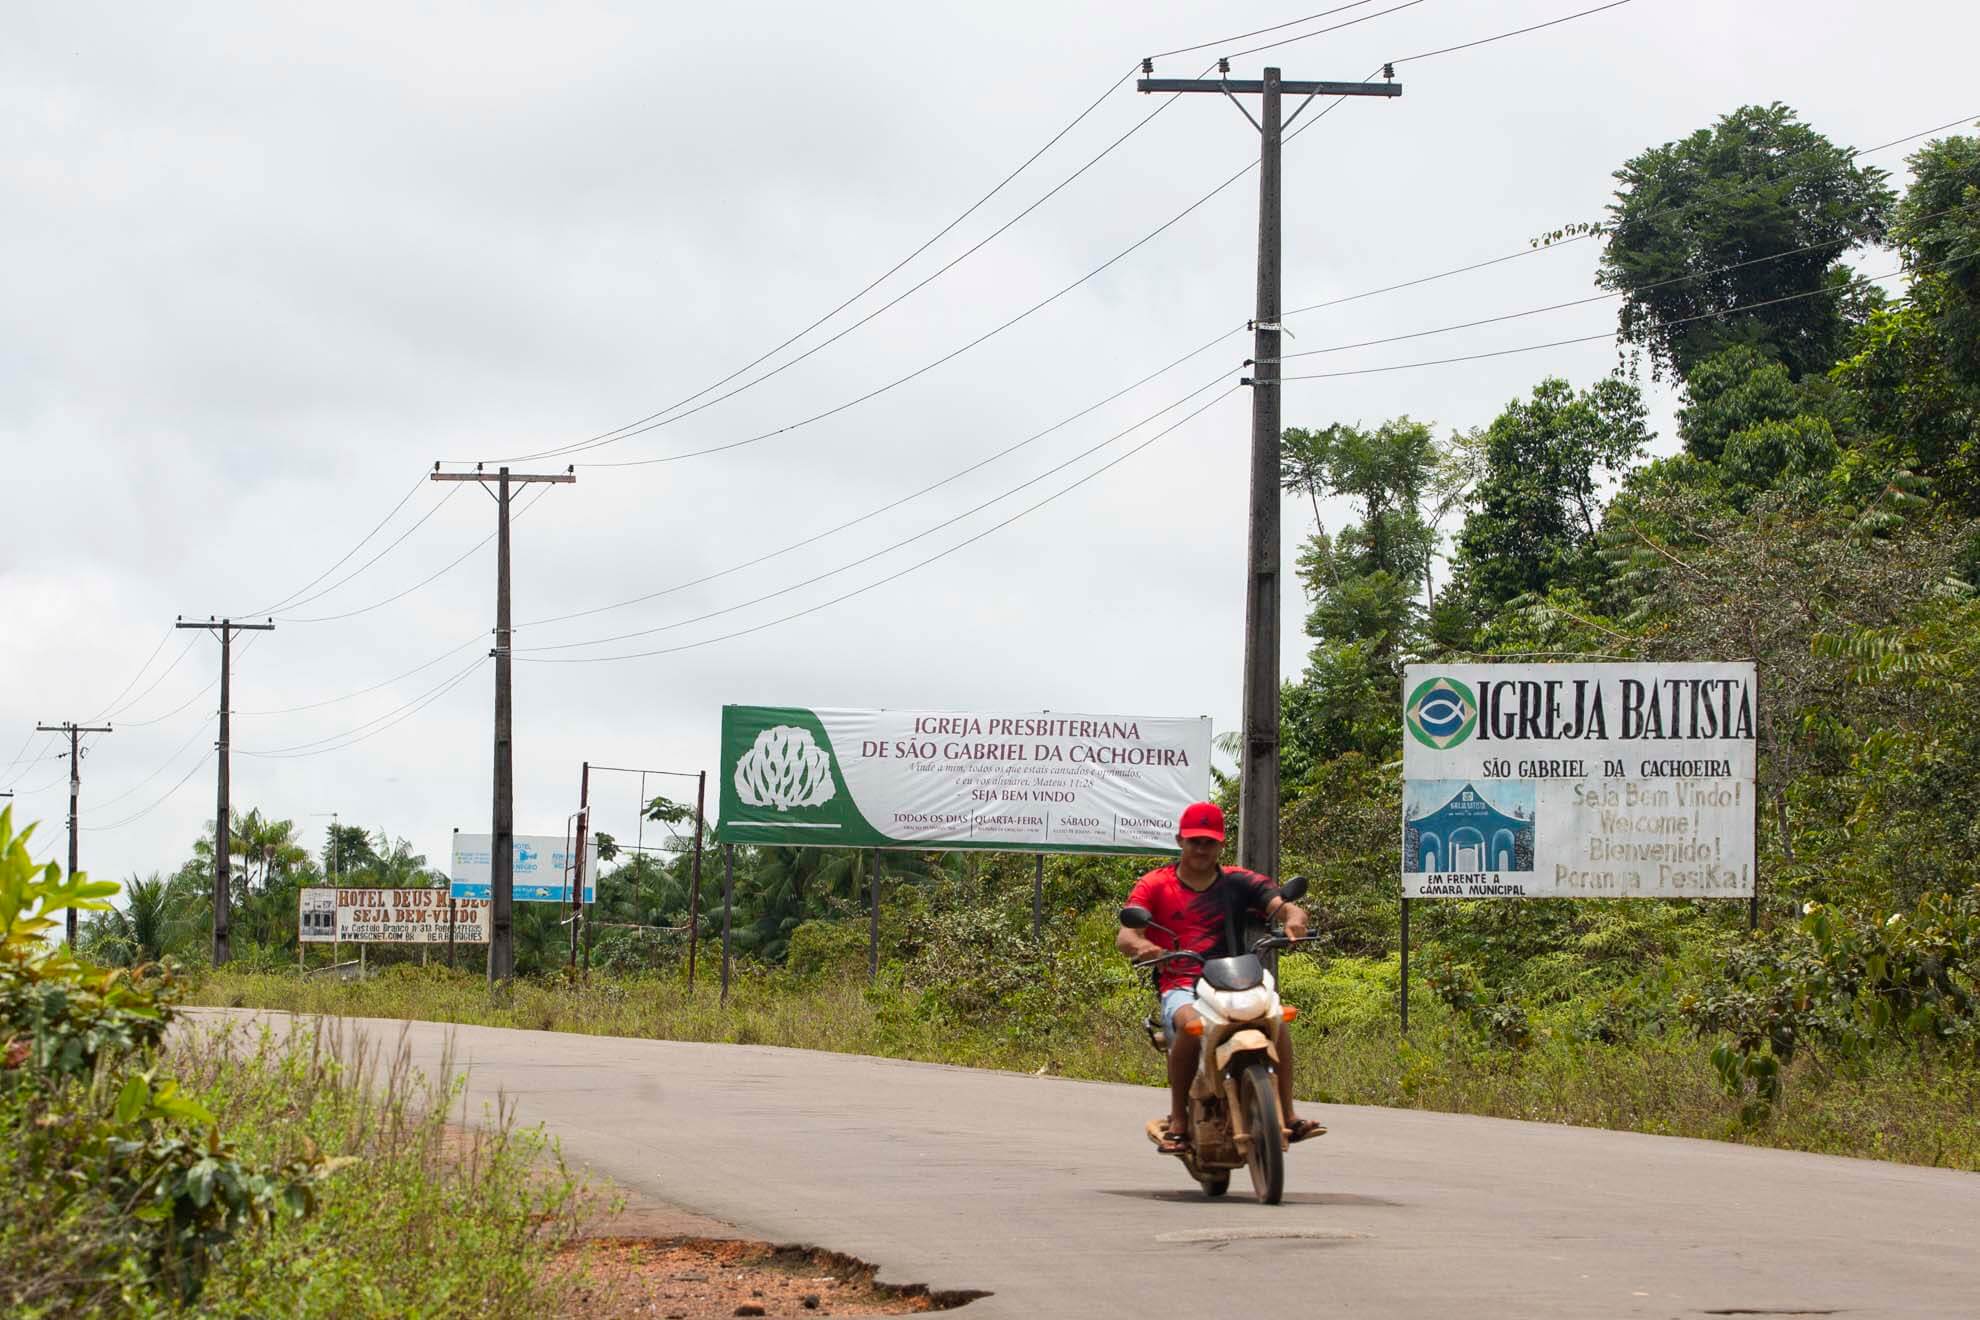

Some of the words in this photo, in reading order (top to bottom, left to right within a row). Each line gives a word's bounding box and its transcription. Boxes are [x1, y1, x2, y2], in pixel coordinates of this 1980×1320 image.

[1477, 679, 1608, 741] IGREJA
[1619, 678, 1755, 740] BATISTA
[915, 716, 981, 738] IGREJA
[988, 718, 1141, 740] PRESBITERIANA
[862, 740, 889, 758] DE
[895, 737, 937, 759] SÃO
[944, 742, 1027, 761] GABRIEL
[1035, 744, 1063, 762] DA
[1069, 746, 1190, 767] CACHOEIRA
[1004, 766, 1021, 777] que
[1023, 765, 1049, 775] estais
[1050, 764, 1089, 777] cansados
[1483, 757, 1511, 778] SÃO
[1518, 760, 1588, 778] GABRIEL
[1604, 759, 1625, 778] DA
[1640, 759, 1733, 778] CACHOEIRA
[971, 788, 997, 802] SEJA
[1002, 789, 1028, 801] BEM
[1032, 791, 1075, 803] VINDO
[894, 813, 928, 823] TODOS
[930, 814, 943, 823] OS
[946, 814, 968, 824] DIAS
[974, 815, 1043, 826] QUARTA-FEIRA
[1060, 815, 1100, 827] SÁBADO
[1120, 817, 1173, 829] DOMINGO
[1428, 875, 1443, 885] EM
[1447, 874, 1487, 884] FRENTE
[1493, 874, 1500, 884] A
[1468, 885, 1526, 896] MUNICIPAL
[338, 890, 385, 907] HOTEL
[392, 890, 432, 907] DEUS
[353, 909, 390, 922] SEJA
